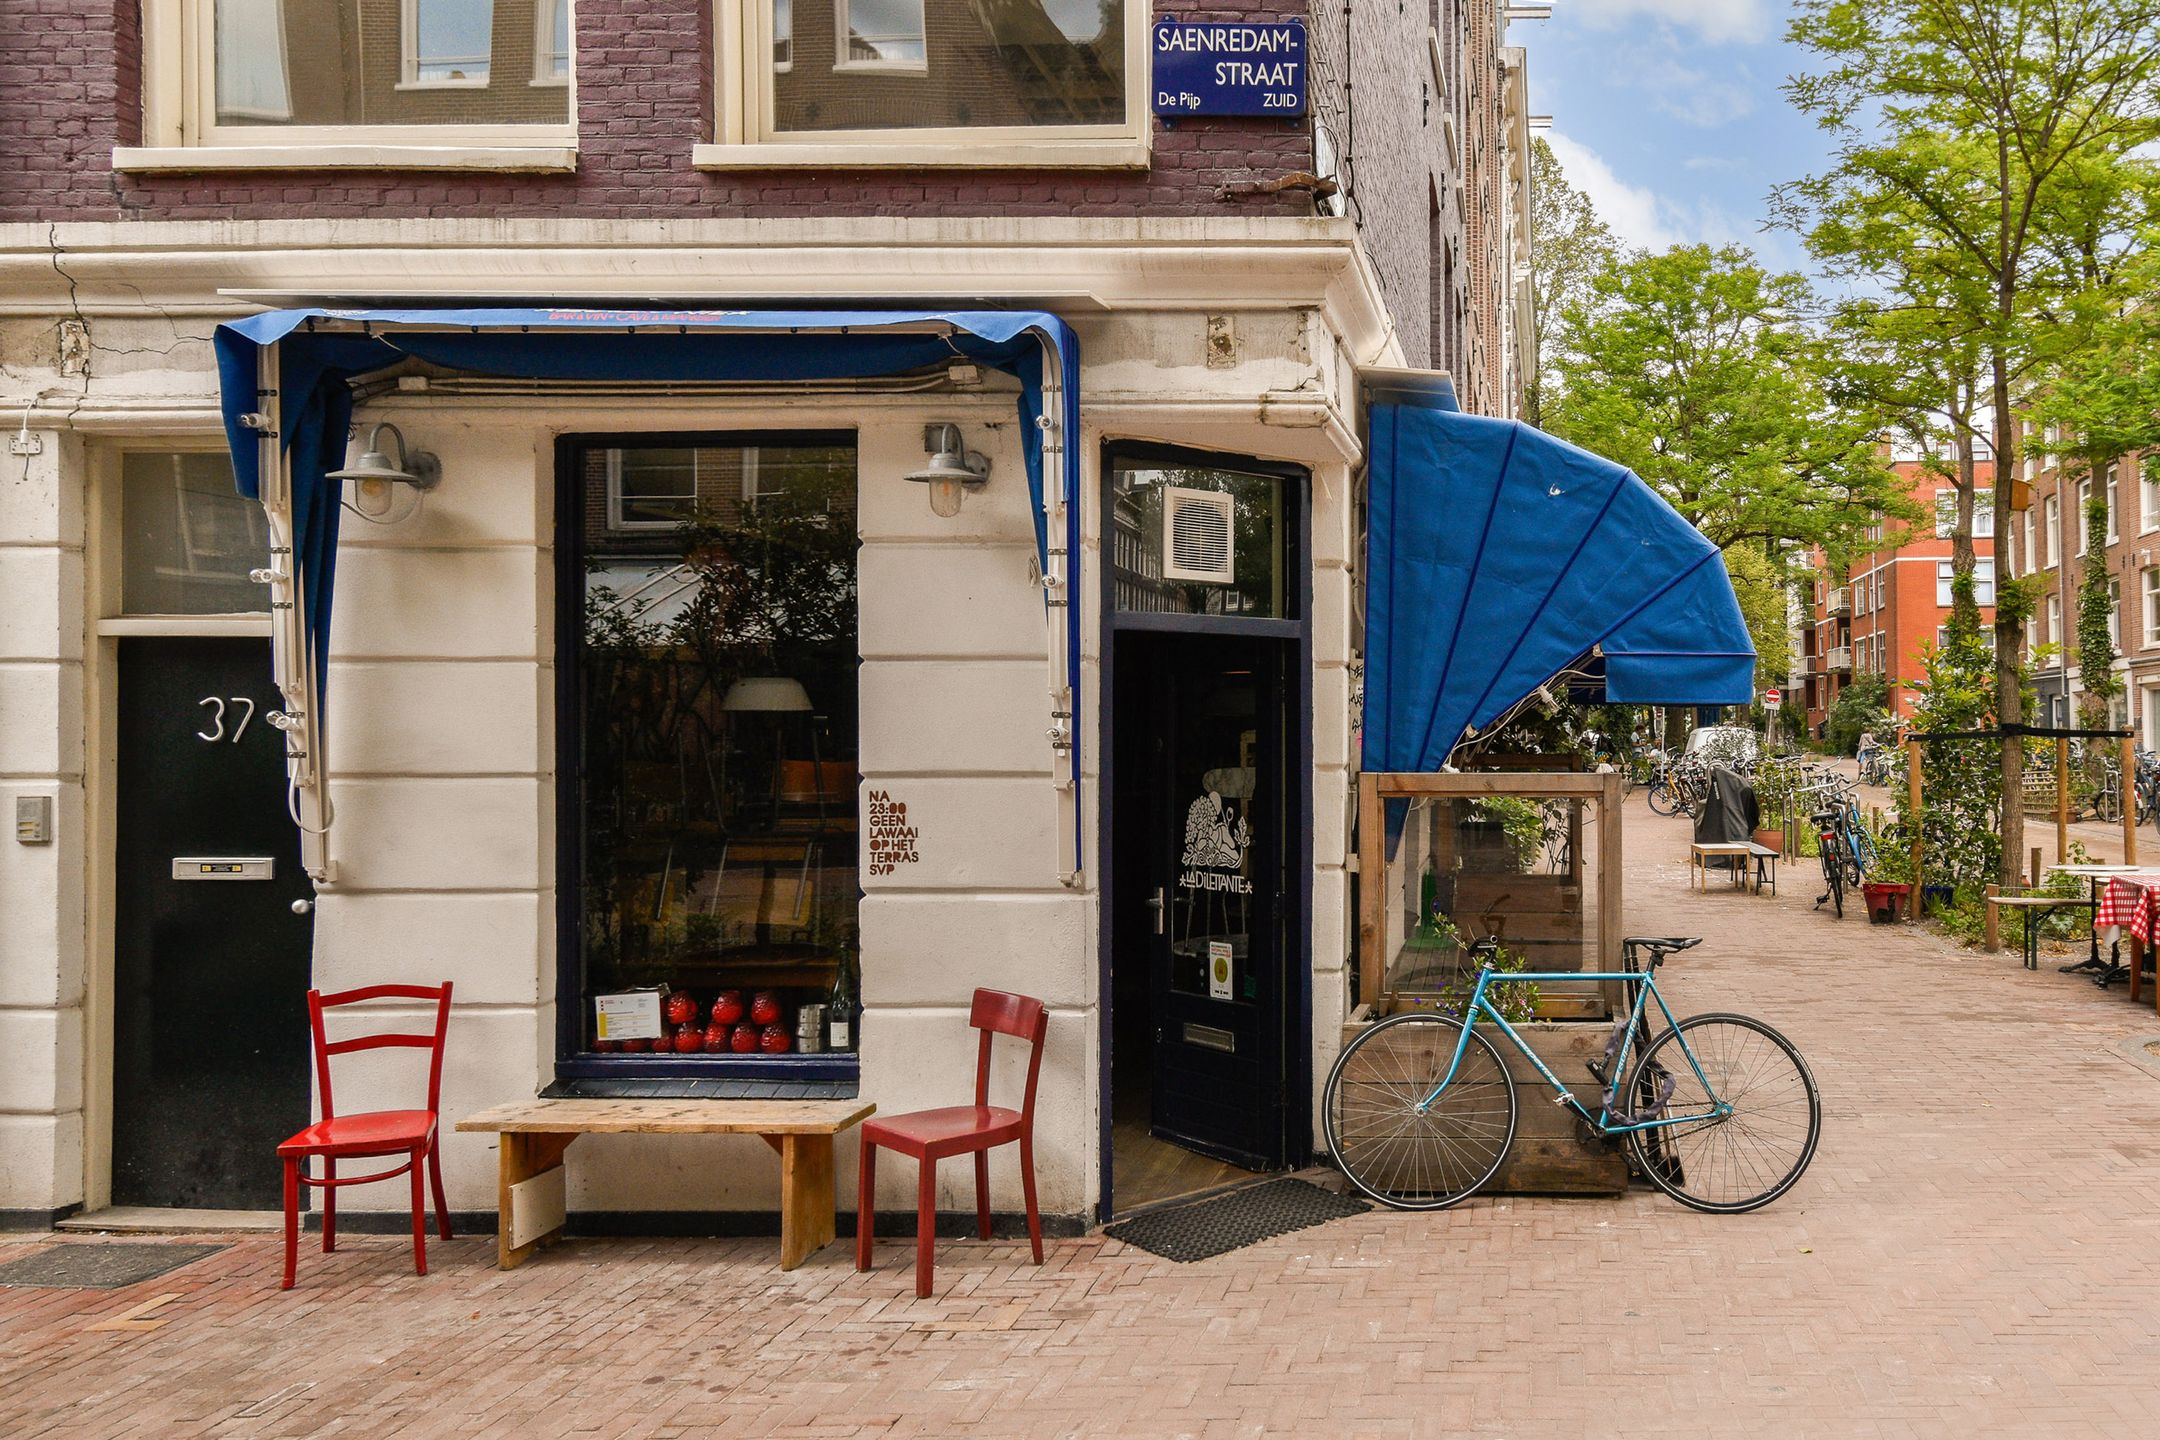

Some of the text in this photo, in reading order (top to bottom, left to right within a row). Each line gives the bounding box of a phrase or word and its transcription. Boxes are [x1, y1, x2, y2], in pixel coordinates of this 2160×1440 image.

[1158, 28, 1298, 52] SAENREDAM-
[1215, 62, 1298, 86] STRAAT
[1158, 92, 1201, 109] De Pijp
[1263, 93, 1297, 108] ZUID
[198, 696, 255, 743] 37
[869, 790, 890, 802] NA
[869, 802, 907, 815] 23:00
[869, 815, 906, 827] GEEN
[869, 827, 919, 839] LAWAAI
[869, 839, 915, 851] OP HET
[869, 851, 919, 863] TERRAS
[869, 864, 895, 876] SVP
